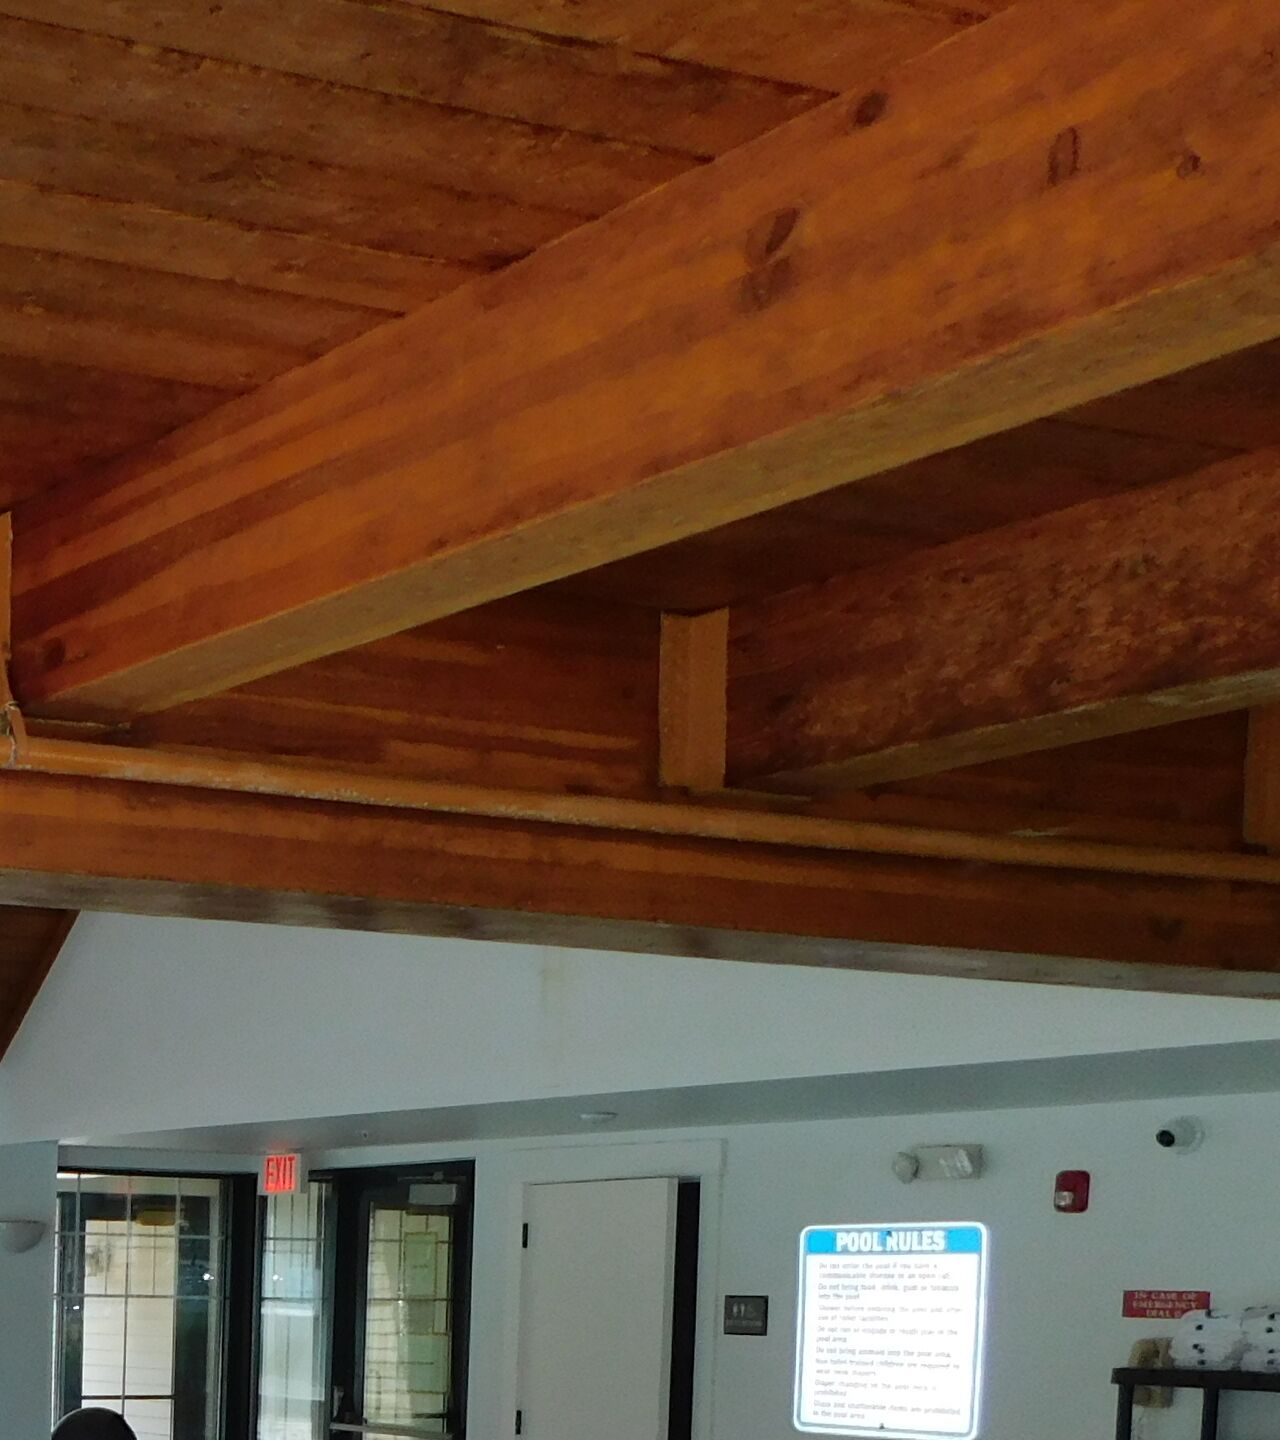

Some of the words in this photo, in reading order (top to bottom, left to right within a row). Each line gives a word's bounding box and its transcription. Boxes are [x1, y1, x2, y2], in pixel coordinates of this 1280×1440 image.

[266, 1155, 296, 1190] EXIT
[836, 1231, 882, 1252] POOL
[885, 1230, 946, 1252] RULES
